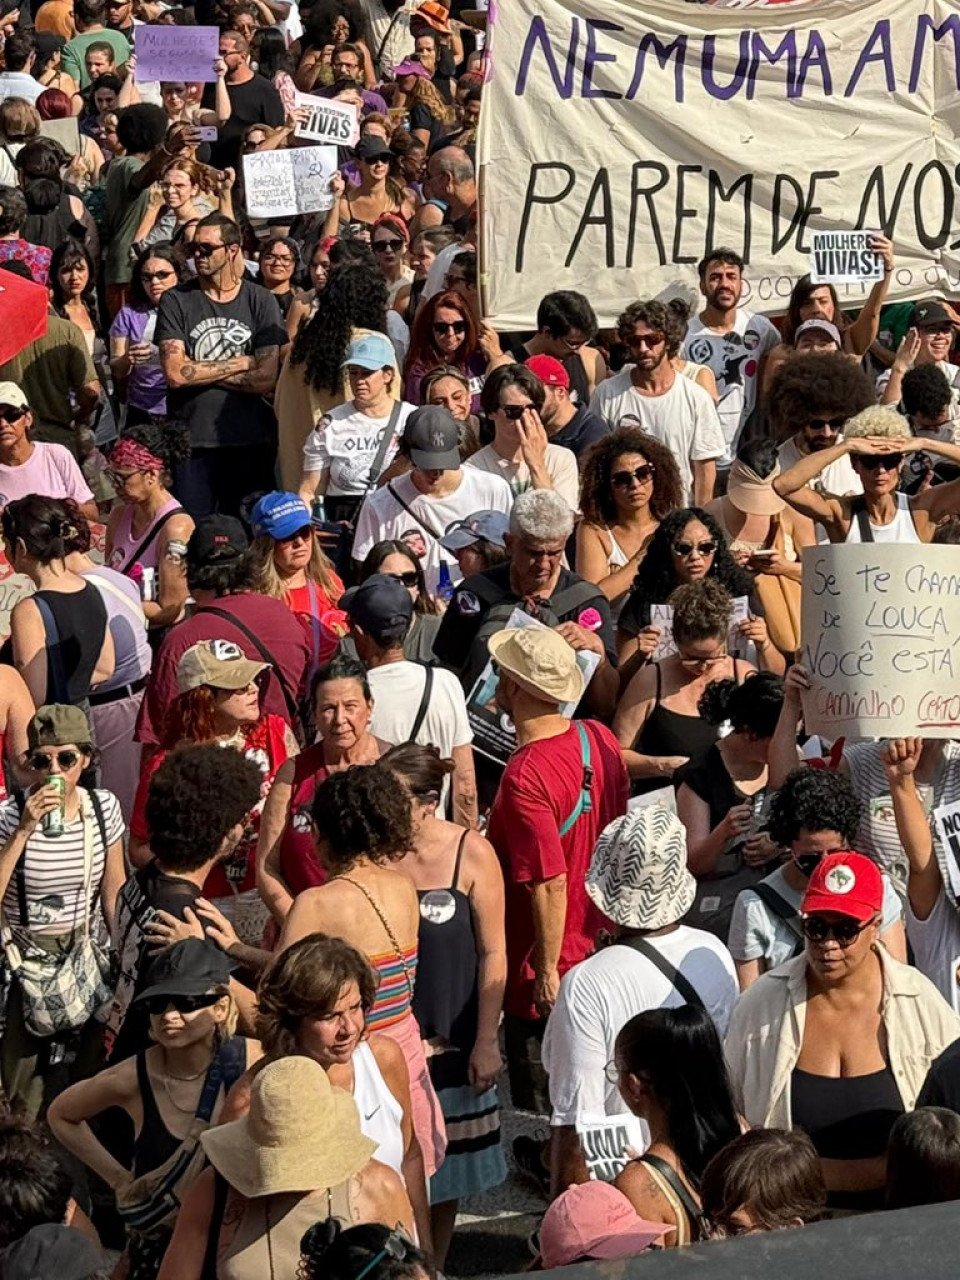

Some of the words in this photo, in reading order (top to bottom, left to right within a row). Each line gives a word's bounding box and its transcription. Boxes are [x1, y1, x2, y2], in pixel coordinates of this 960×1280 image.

[515, 15, 688, 102] NEM
[701, 29, 833, 100] UMA
[844, 19, 896, 97] A
[515, 159, 753, 273] PAREM
[771, 171, 839, 254] DE
[813, 234, 874, 251] MULHERE
[814, 250, 880, 276] VIVAS!
